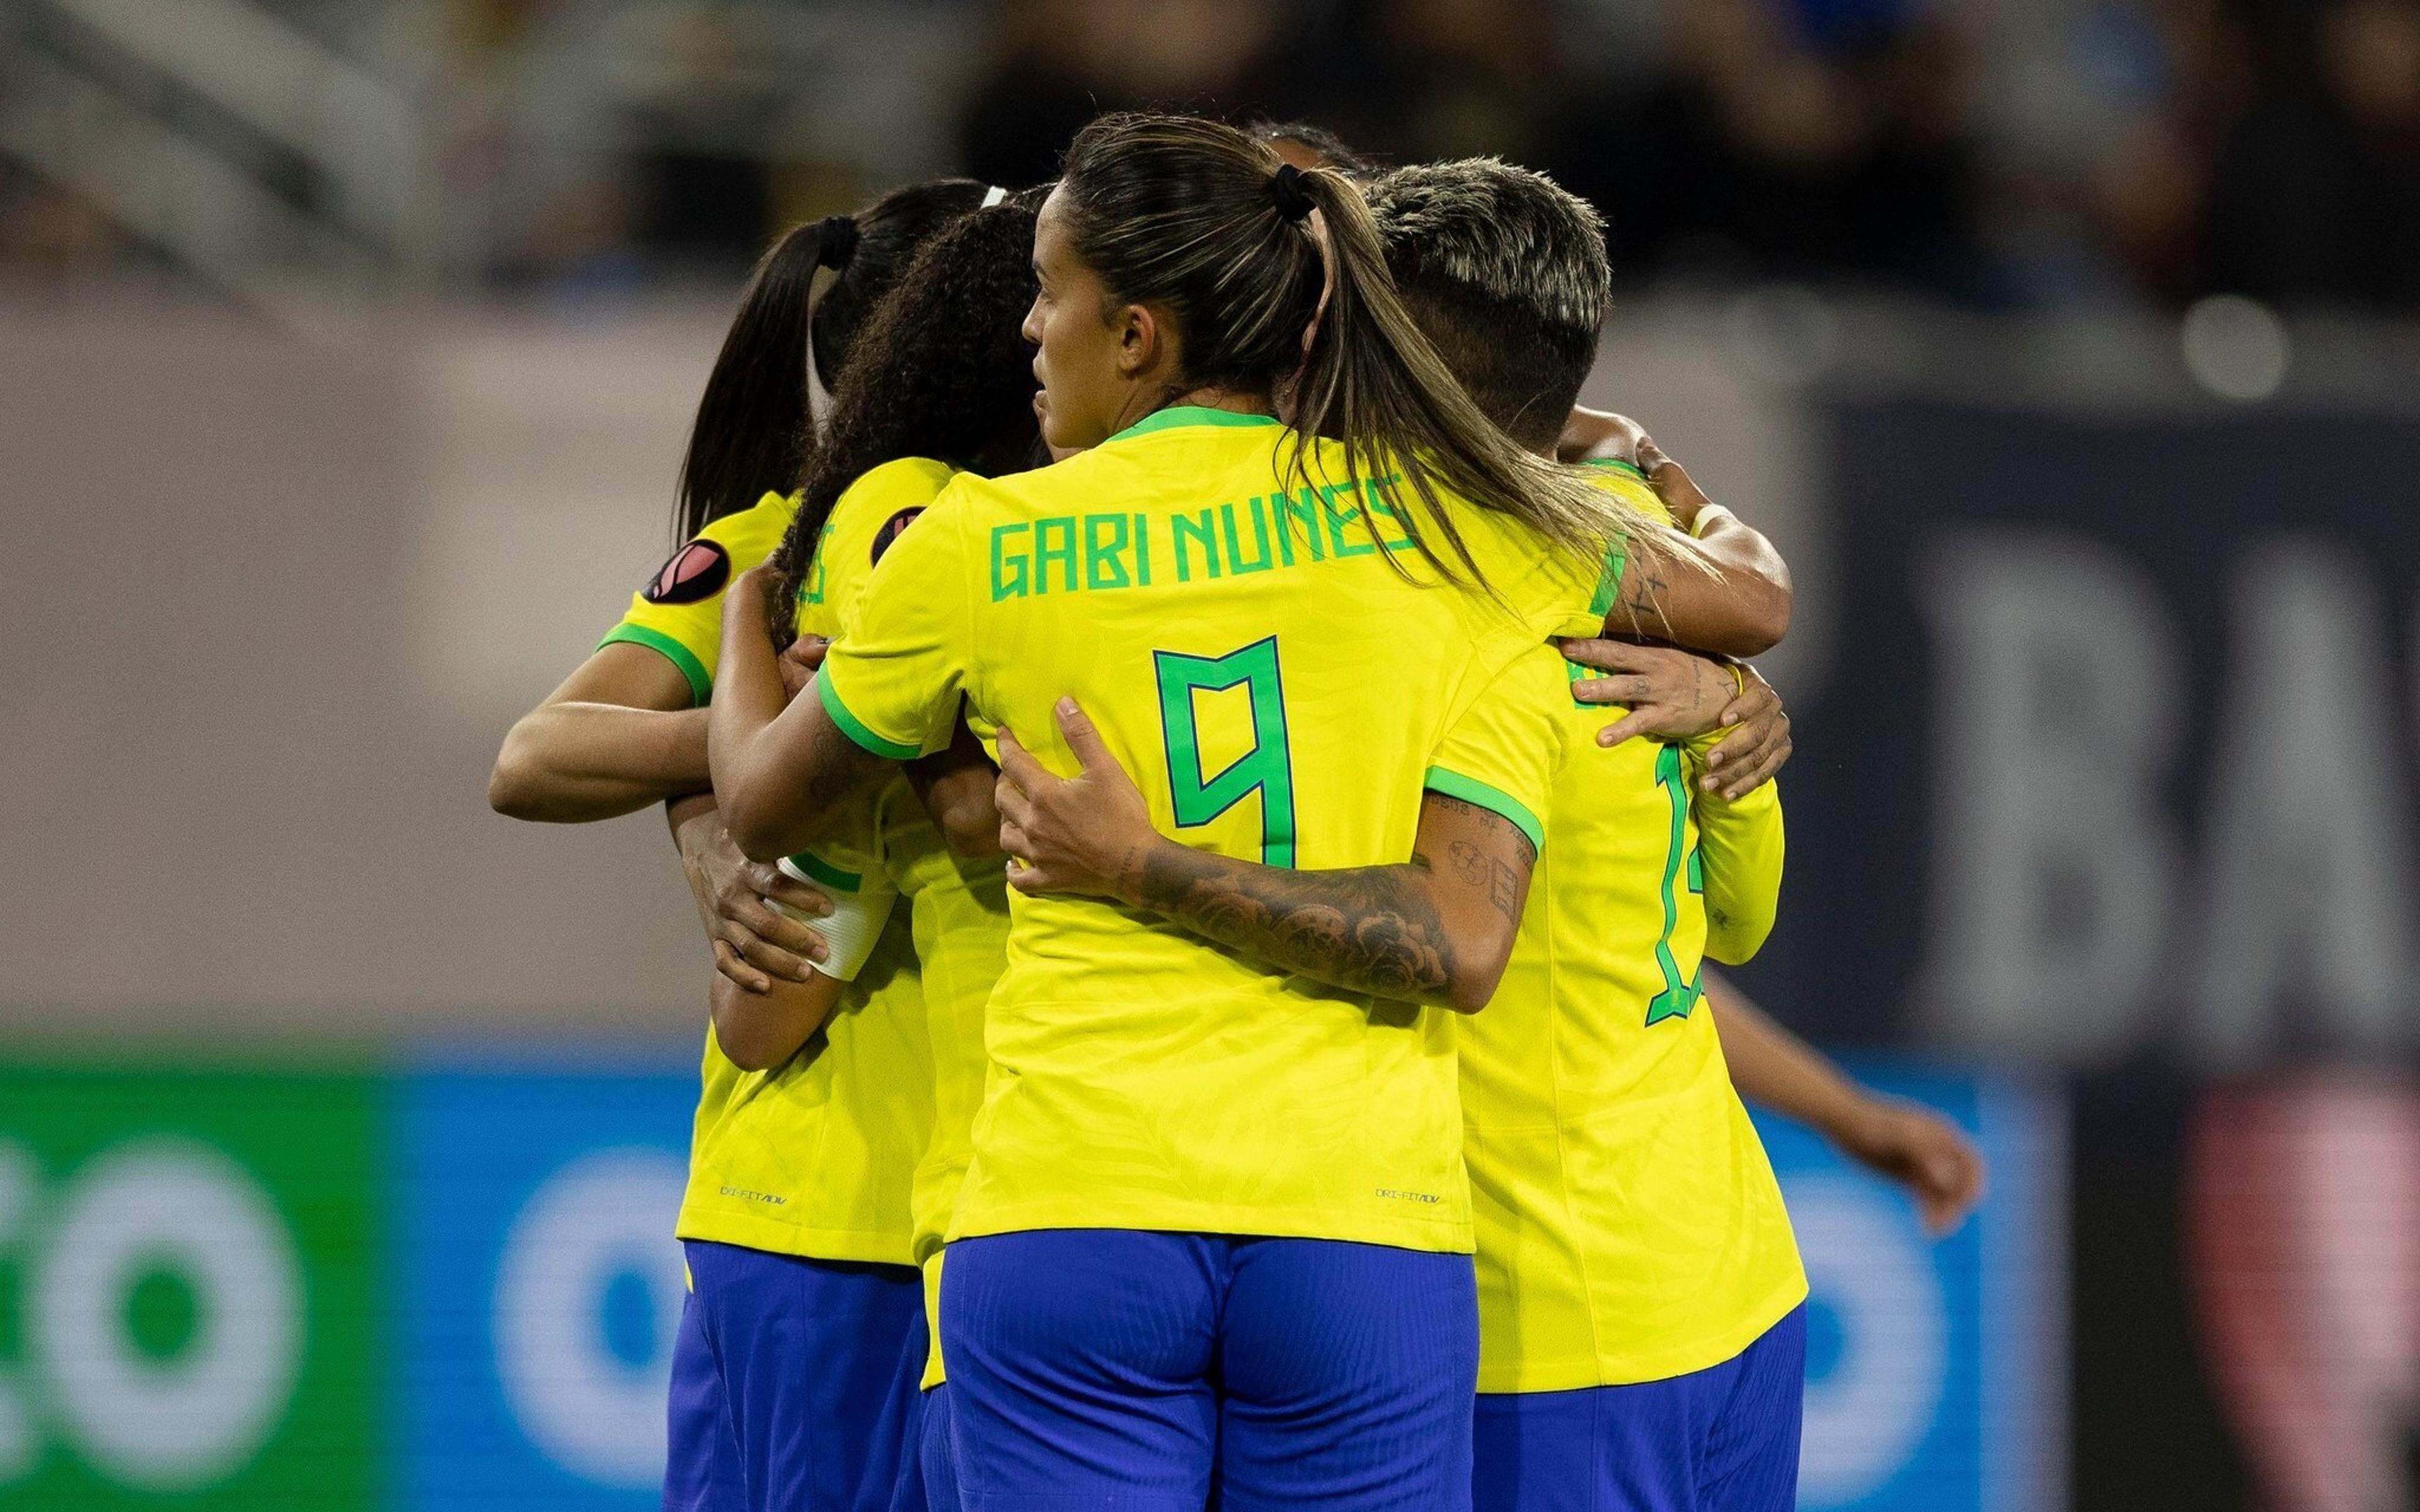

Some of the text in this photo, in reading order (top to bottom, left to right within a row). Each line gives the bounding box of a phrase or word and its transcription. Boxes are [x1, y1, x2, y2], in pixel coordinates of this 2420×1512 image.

[991, 474, 1419, 603] GABI NUNES
[1153, 634, 1296, 870] 9
